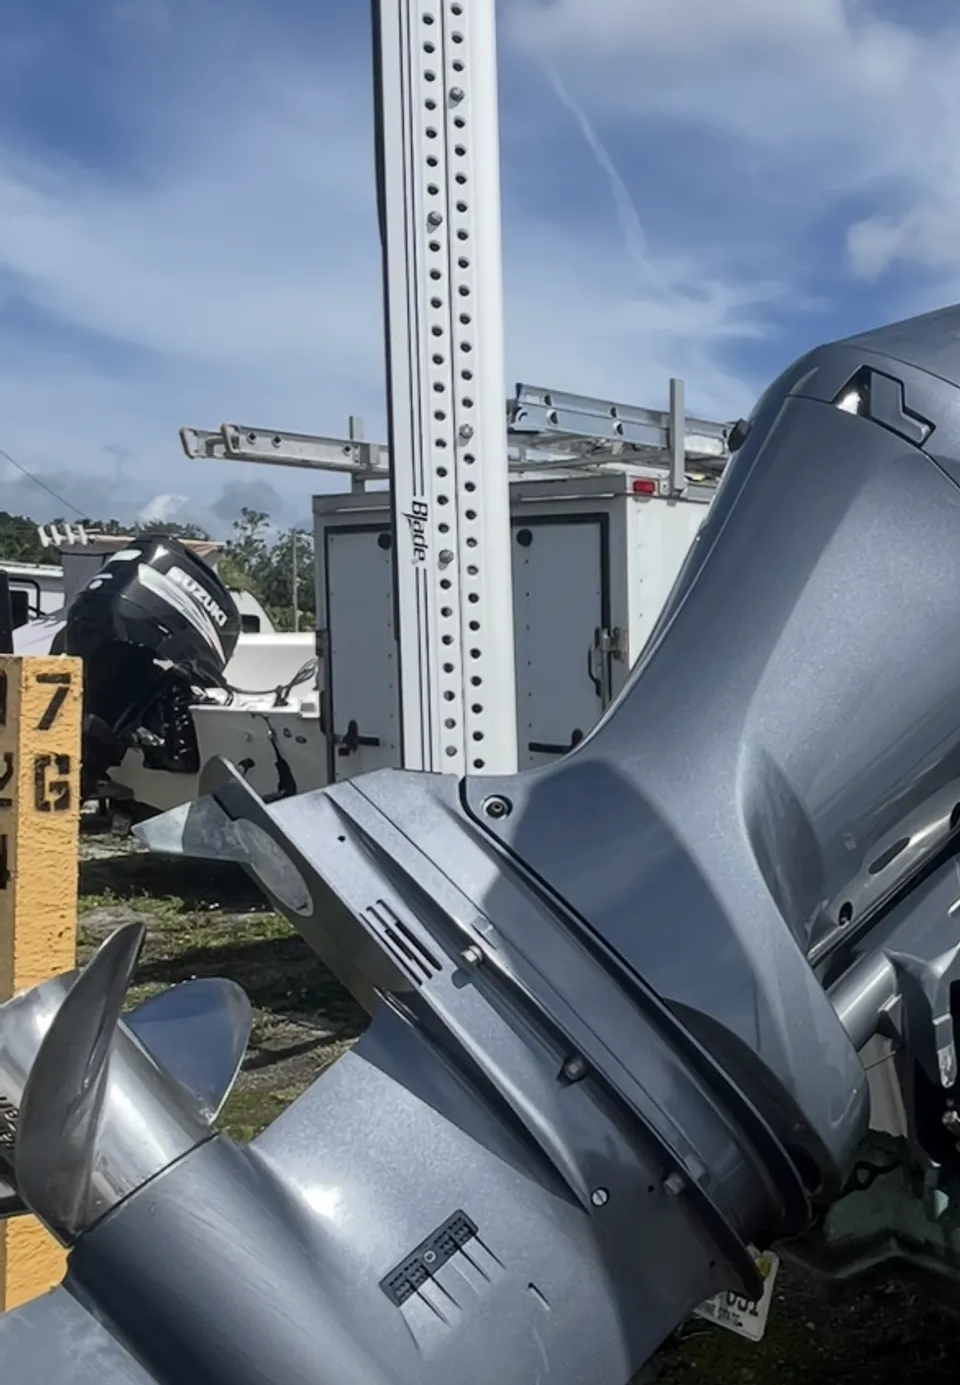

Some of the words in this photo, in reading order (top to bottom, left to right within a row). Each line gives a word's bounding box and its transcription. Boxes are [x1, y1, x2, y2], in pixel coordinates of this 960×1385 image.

[402, 501, 429, 561] Blade
[165, 566, 228, 627] SUZUKI
[36, 673, 71, 731] 7
[34, 753, 71, 812] G
